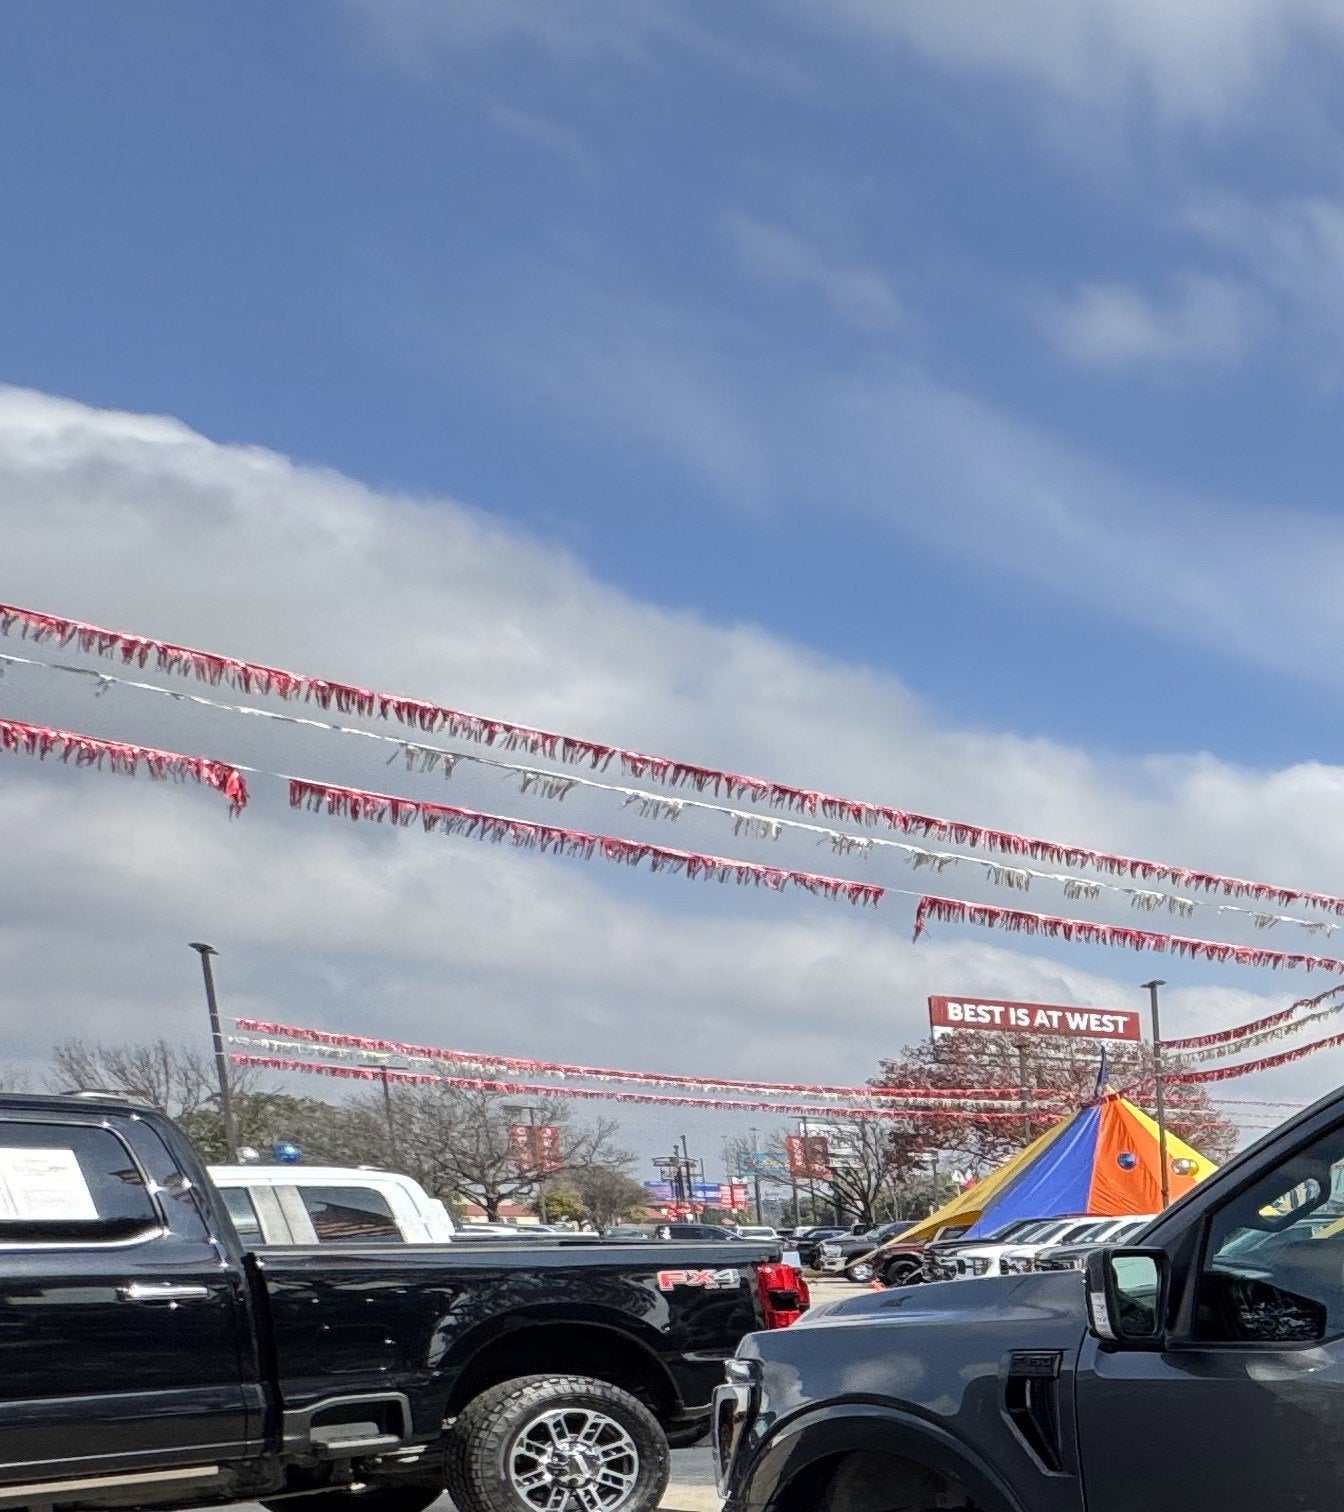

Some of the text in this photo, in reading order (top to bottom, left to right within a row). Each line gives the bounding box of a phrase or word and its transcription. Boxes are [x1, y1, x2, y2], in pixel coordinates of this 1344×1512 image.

[947, 1002, 1131, 1034] BEST IS AT WEST
[656, 1269, 741, 1291] FX4
